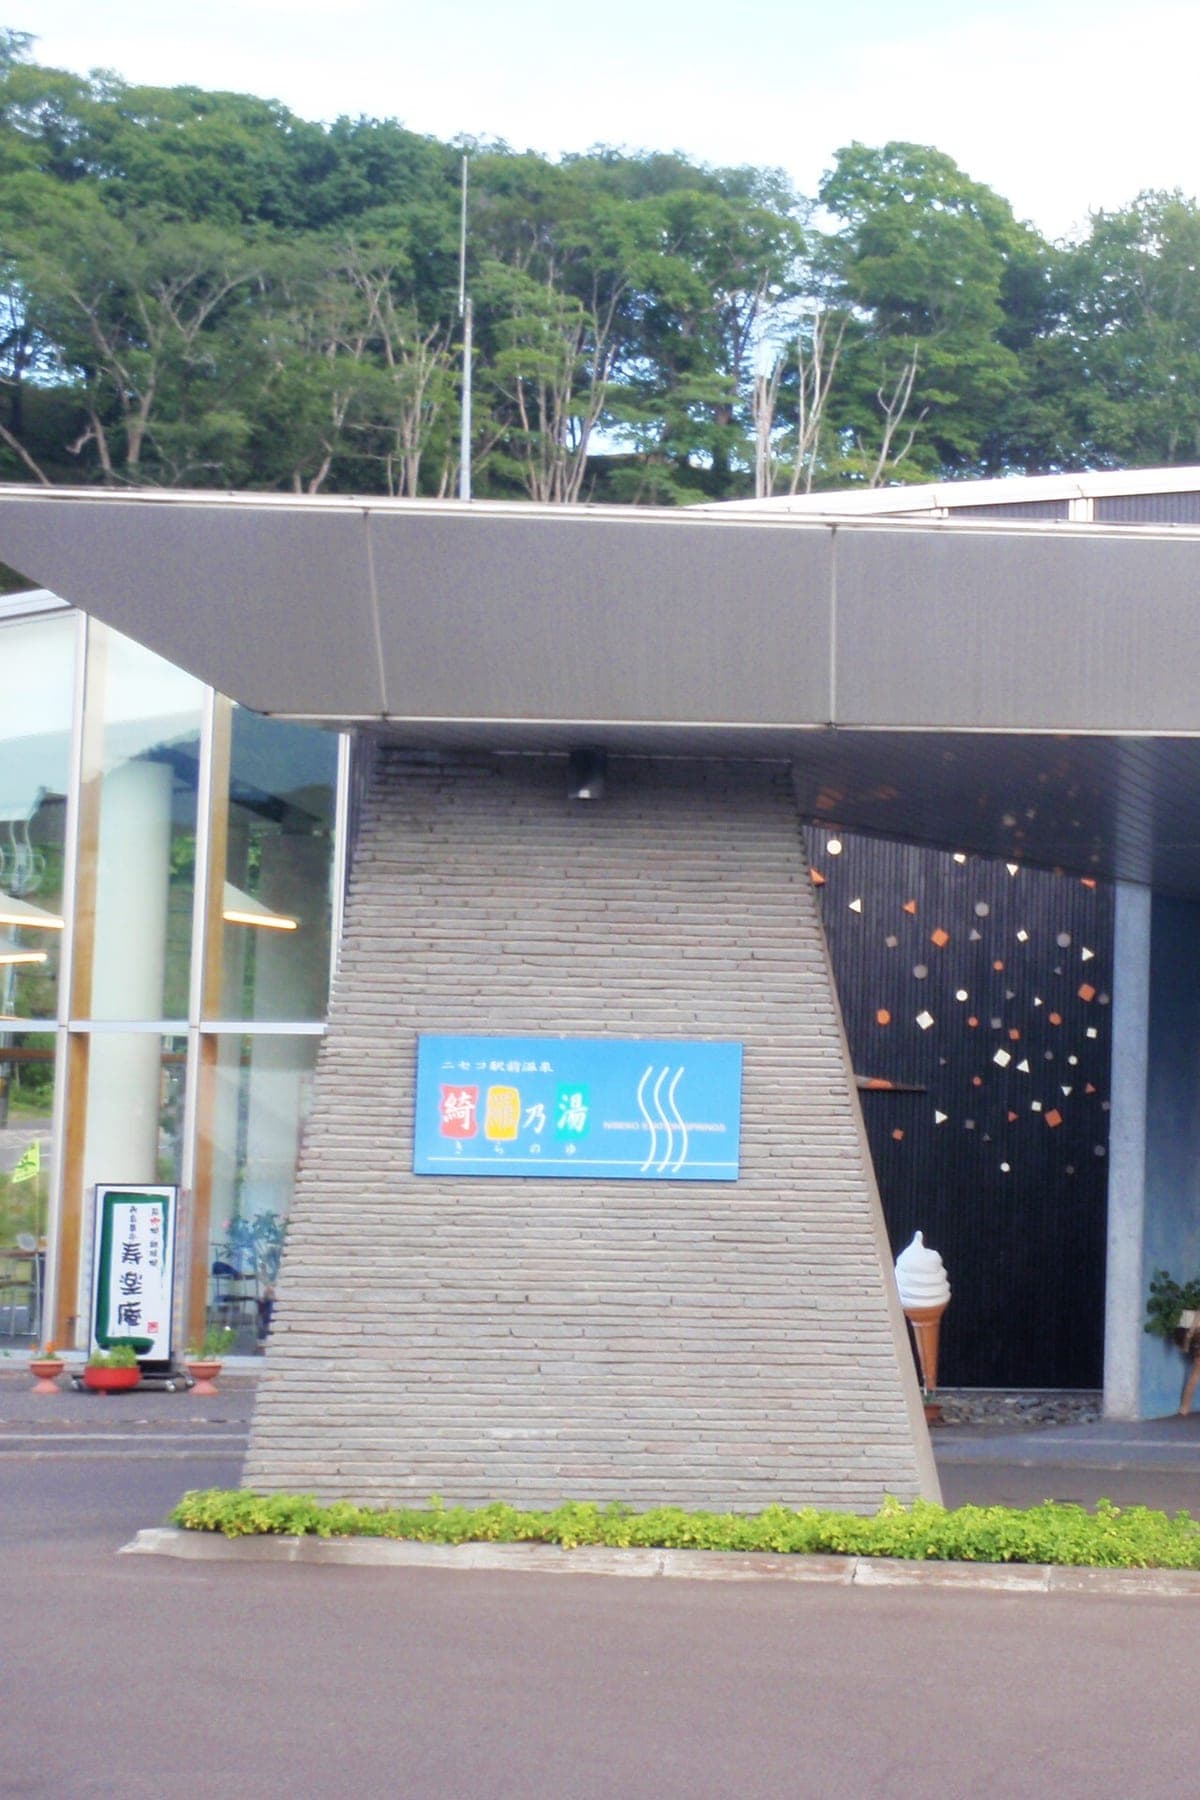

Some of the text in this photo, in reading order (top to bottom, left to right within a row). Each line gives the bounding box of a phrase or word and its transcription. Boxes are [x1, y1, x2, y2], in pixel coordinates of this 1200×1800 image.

[441, 1059, 554, 1073] ニセコ駅前温泉
